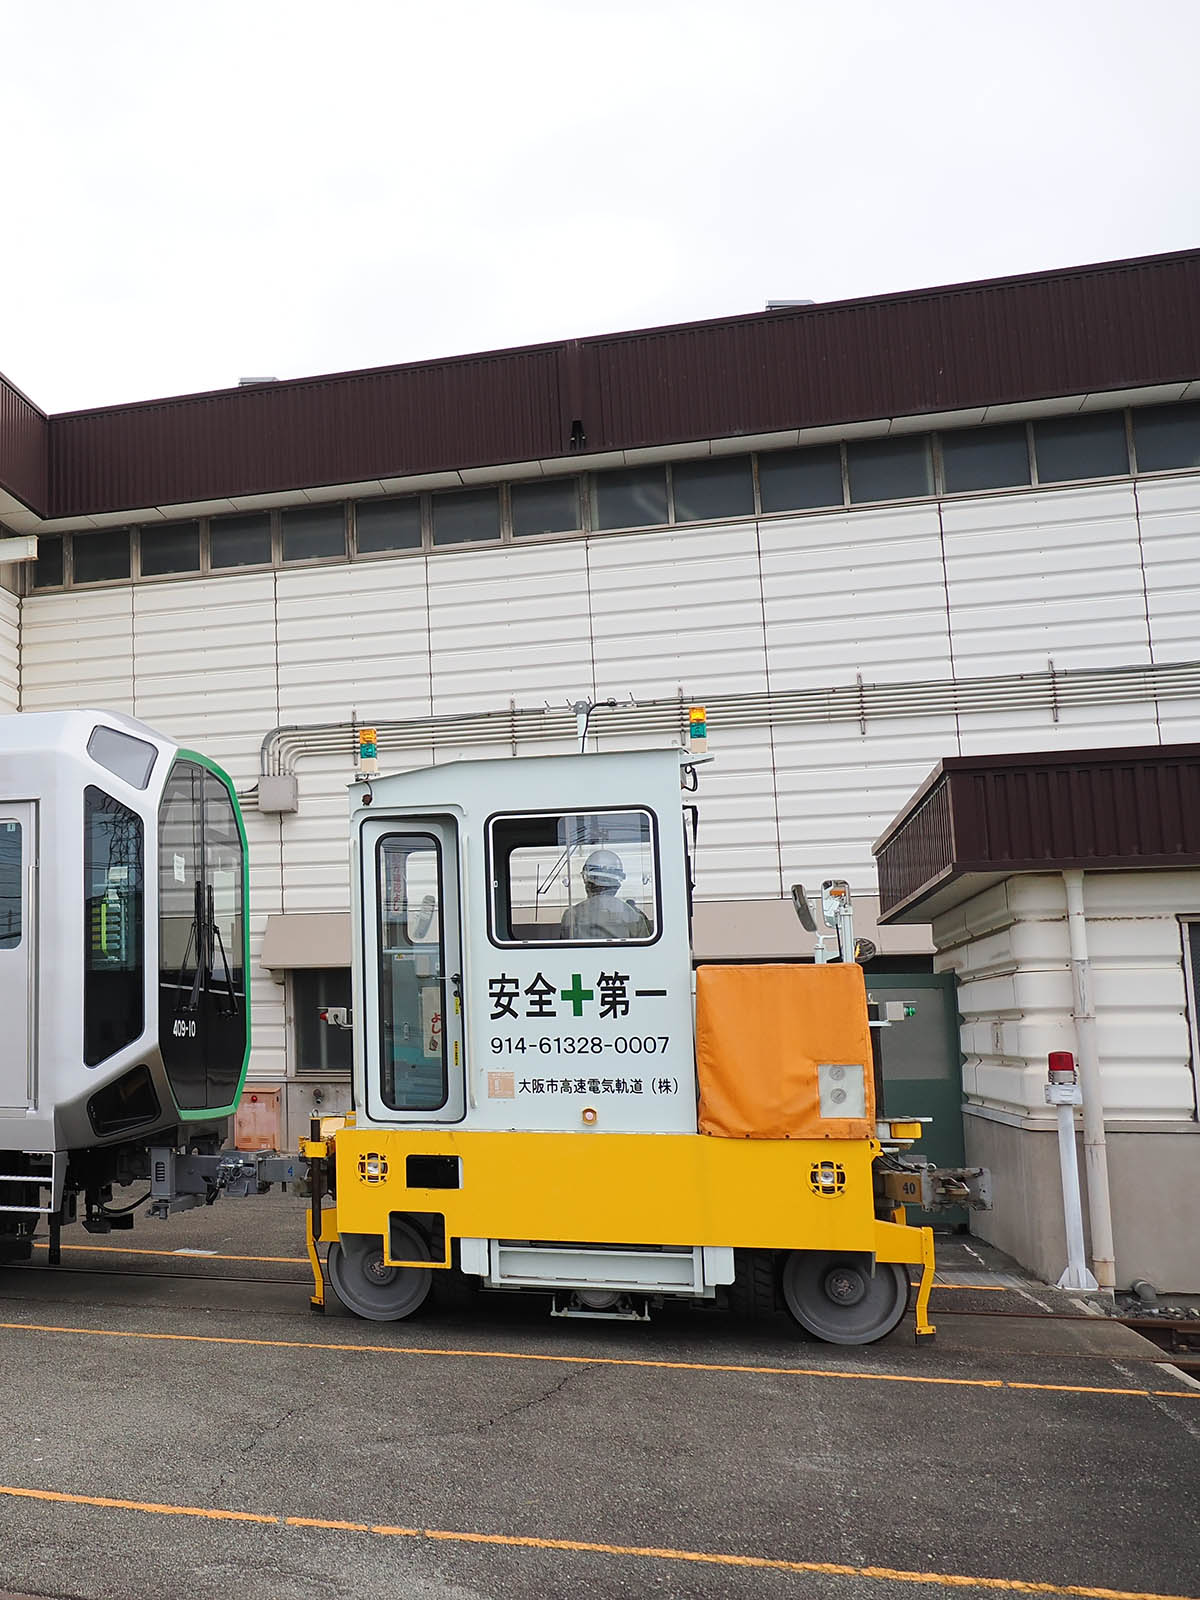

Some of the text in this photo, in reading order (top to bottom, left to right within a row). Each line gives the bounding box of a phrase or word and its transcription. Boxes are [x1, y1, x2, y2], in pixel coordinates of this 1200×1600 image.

[488, 971, 668, 1021] 安全 第一
[172, 1019, 196, 1037] 409-10
[490, 1036, 670, 1055] 914-61328-0007
[903, 1182, 916, 1195] 40
